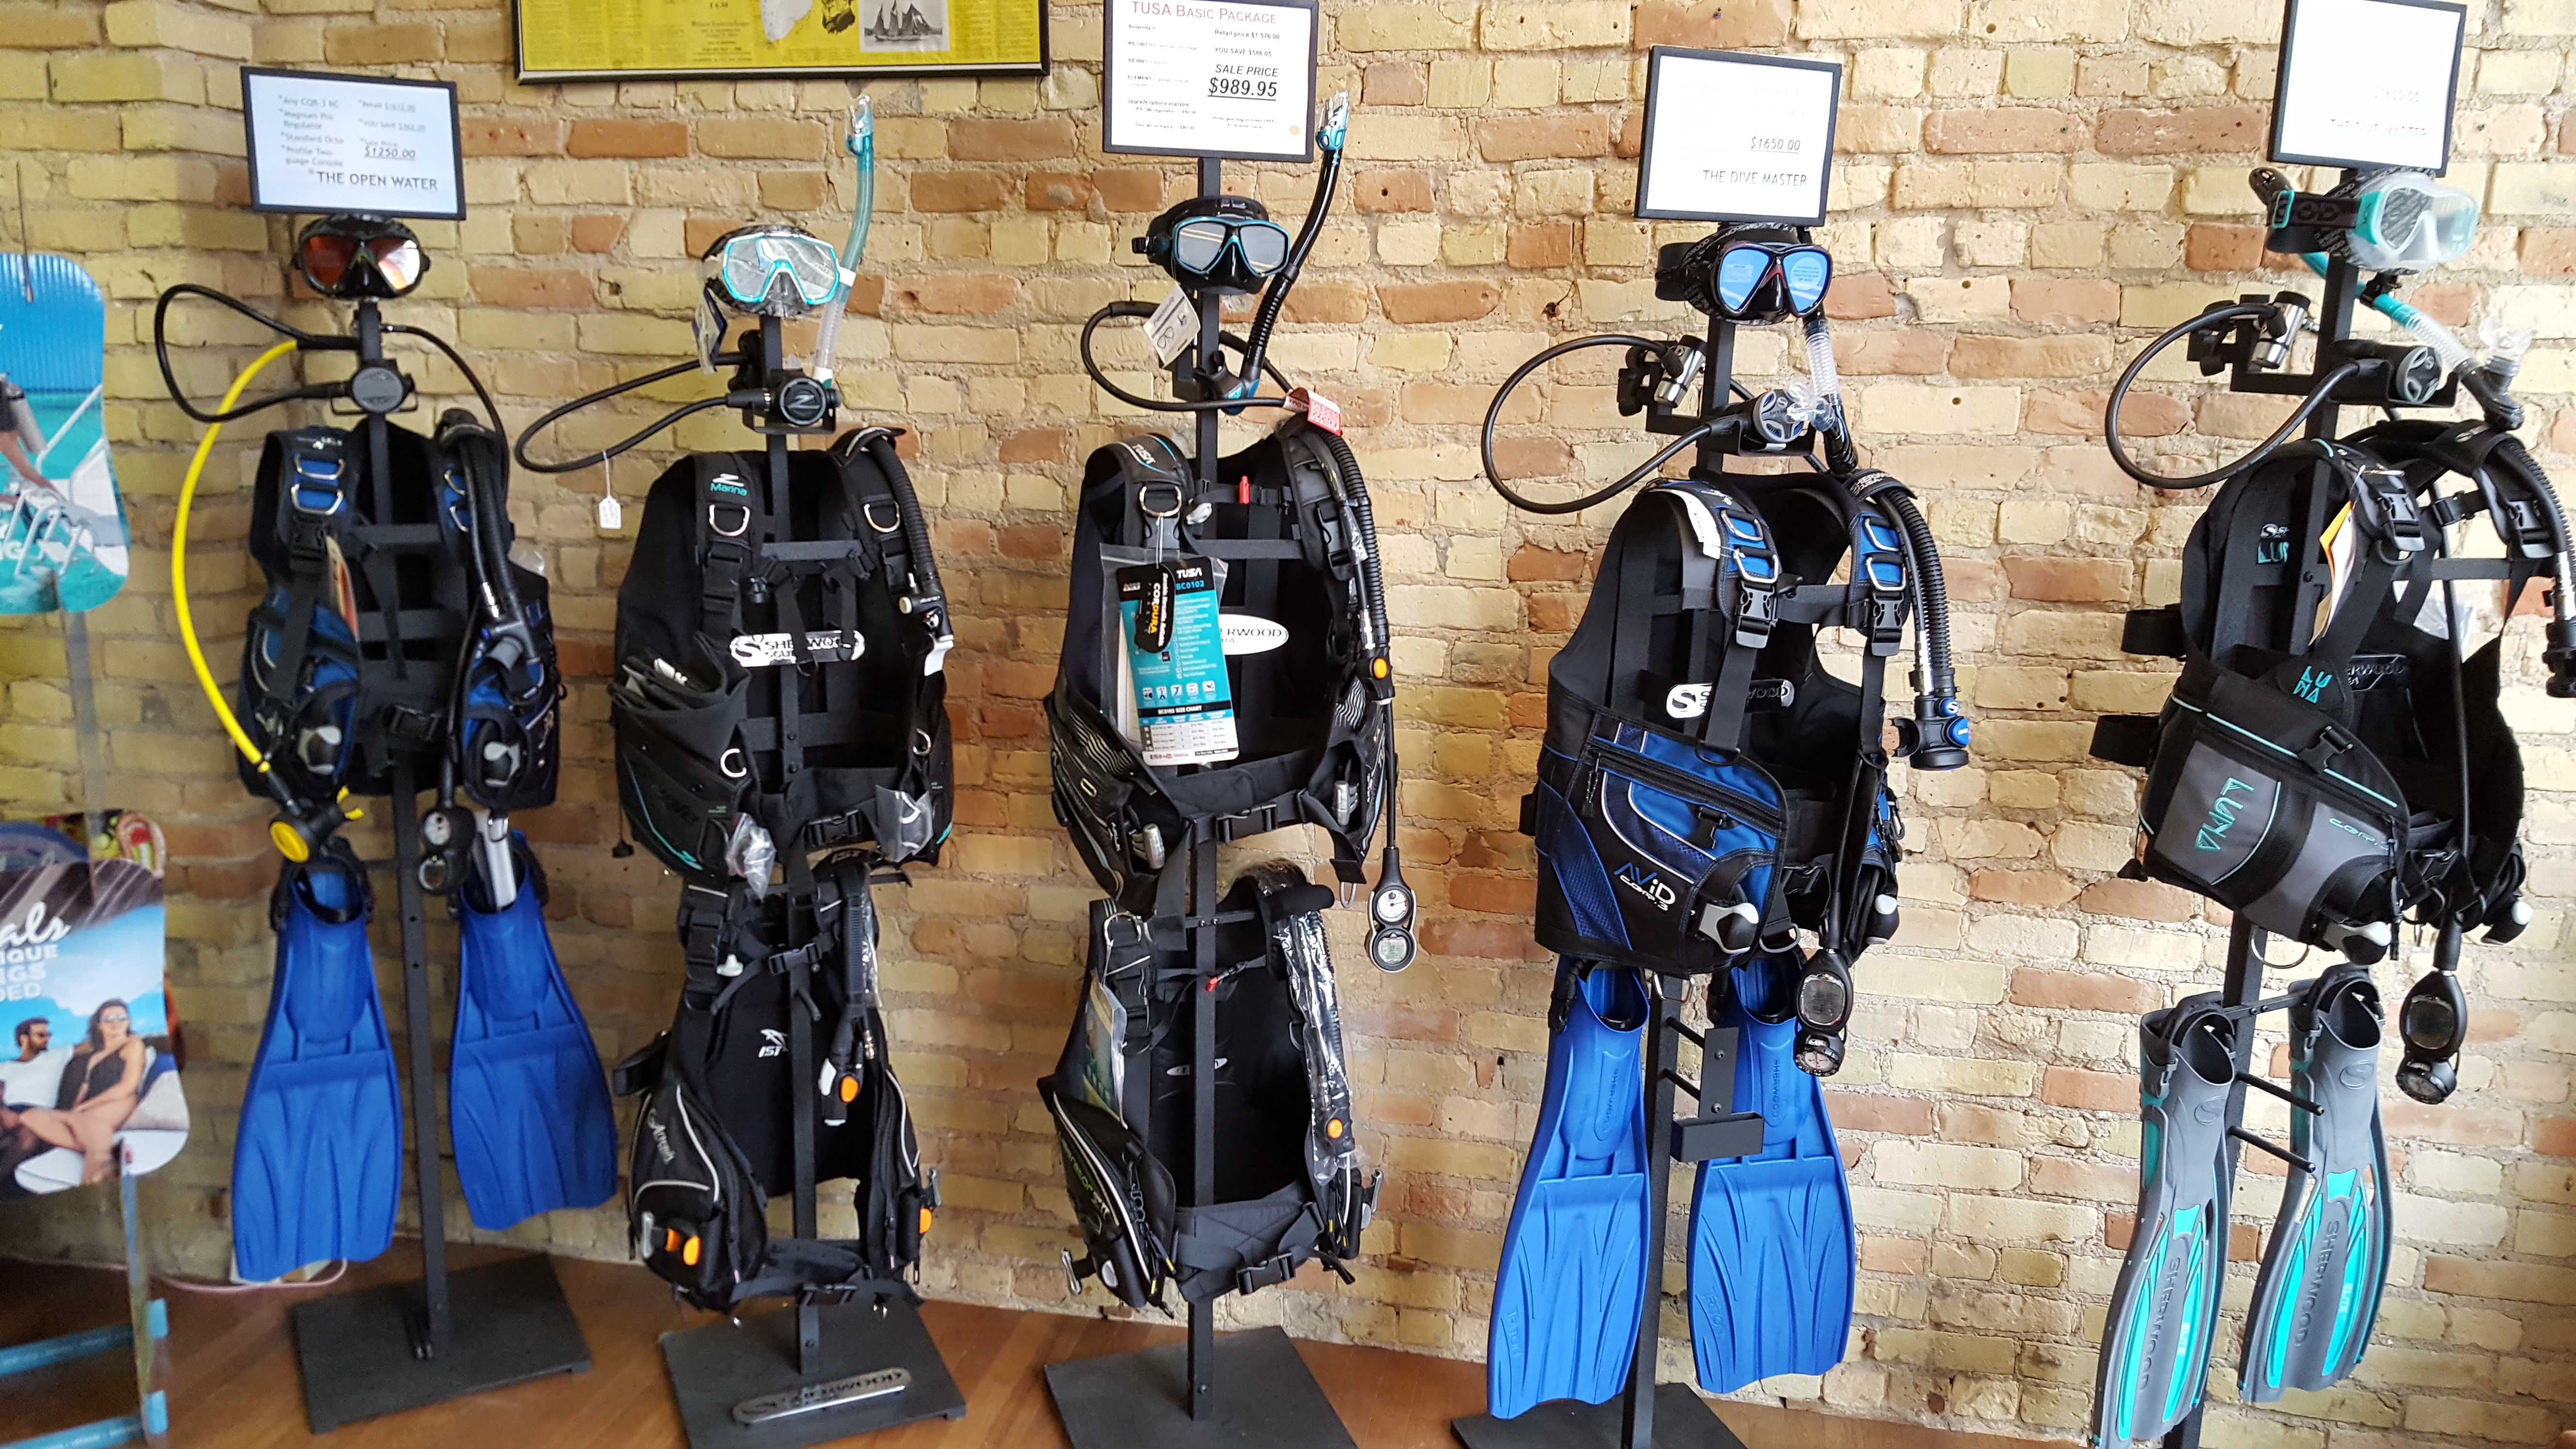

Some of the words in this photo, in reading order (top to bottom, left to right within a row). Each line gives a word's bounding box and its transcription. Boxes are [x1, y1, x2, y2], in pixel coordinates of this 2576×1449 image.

[1131, 1, 1172, 16] TUSA
[1219, 8, 1277, 24] PACKAGE
[1215, 64, 1244, 75] SALE
[1246, 66, 1279, 77] PRICE
[1208, 77, 1277, 97] $989.95
[2374, 85, 2421, 103] 65000
[365, 146, 416, 160] $1250.00
[1751, 136, 1801, 152] $1650.00
[317, 171, 345, 184] THE
[350, 173, 386, 186] OPEN
[391, 176, 438, 190] WATER
[1703, 170, 1726, 183] THE
[1730, 171, 1758, 184] DIVE
[1762, 173, 1807, 187] MASTER
[1132, 443, 1156, 464] TUSA
[710, 482, 747, 496] Marina
[1176, 568, 1202, 579] TUSA
[1175, 580, 1205, 590] BC0102
[1149, 582, 1161, 634] CORDURA
[1220, 628, 1282, 637] RWOOD
[2193, 777, 2254, 851] LUNA
[758, 1045, 783, 1059] IST
[1771, 1058, 1781, 1120] SHERWOOD
[2294, 1220, 2339, 1347] SHERWOOD
[2339, 1283, 2353, 1313] ELITE
[2139, 1257, 2181, 1393] SHERWOOD
